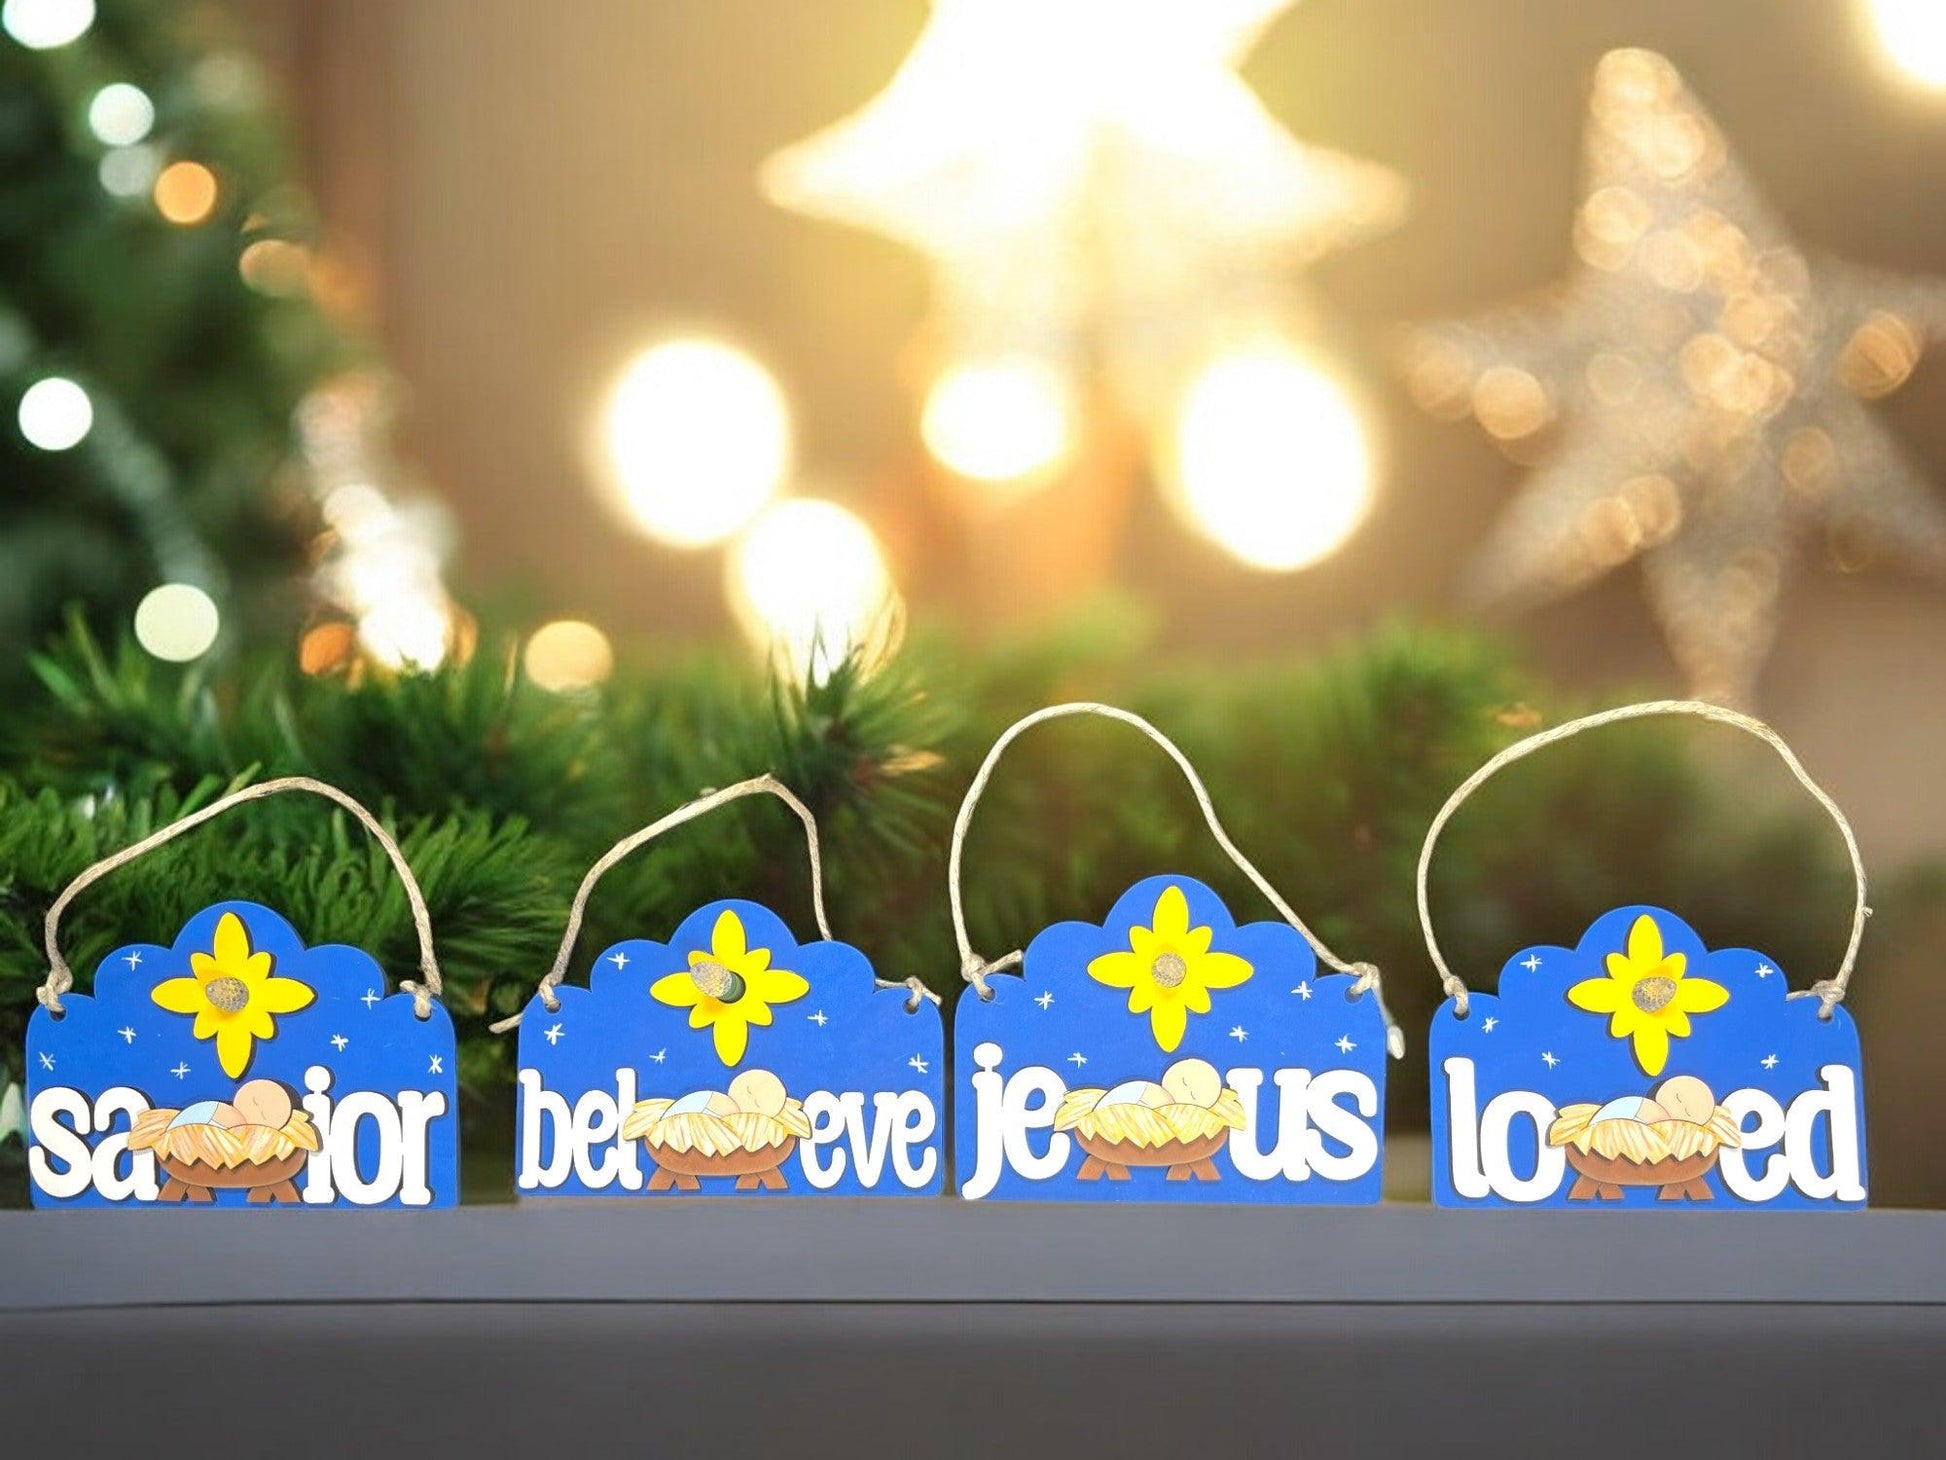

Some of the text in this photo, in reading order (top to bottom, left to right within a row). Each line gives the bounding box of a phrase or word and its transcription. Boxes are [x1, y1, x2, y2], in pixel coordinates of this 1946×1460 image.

[28, 1065, 446, 1205] saior
[518, 1067, 938, 1190] beleve
[961, 1042, 1379, 1200] jeus
[1443, 1057, 1867, 1202] loed
